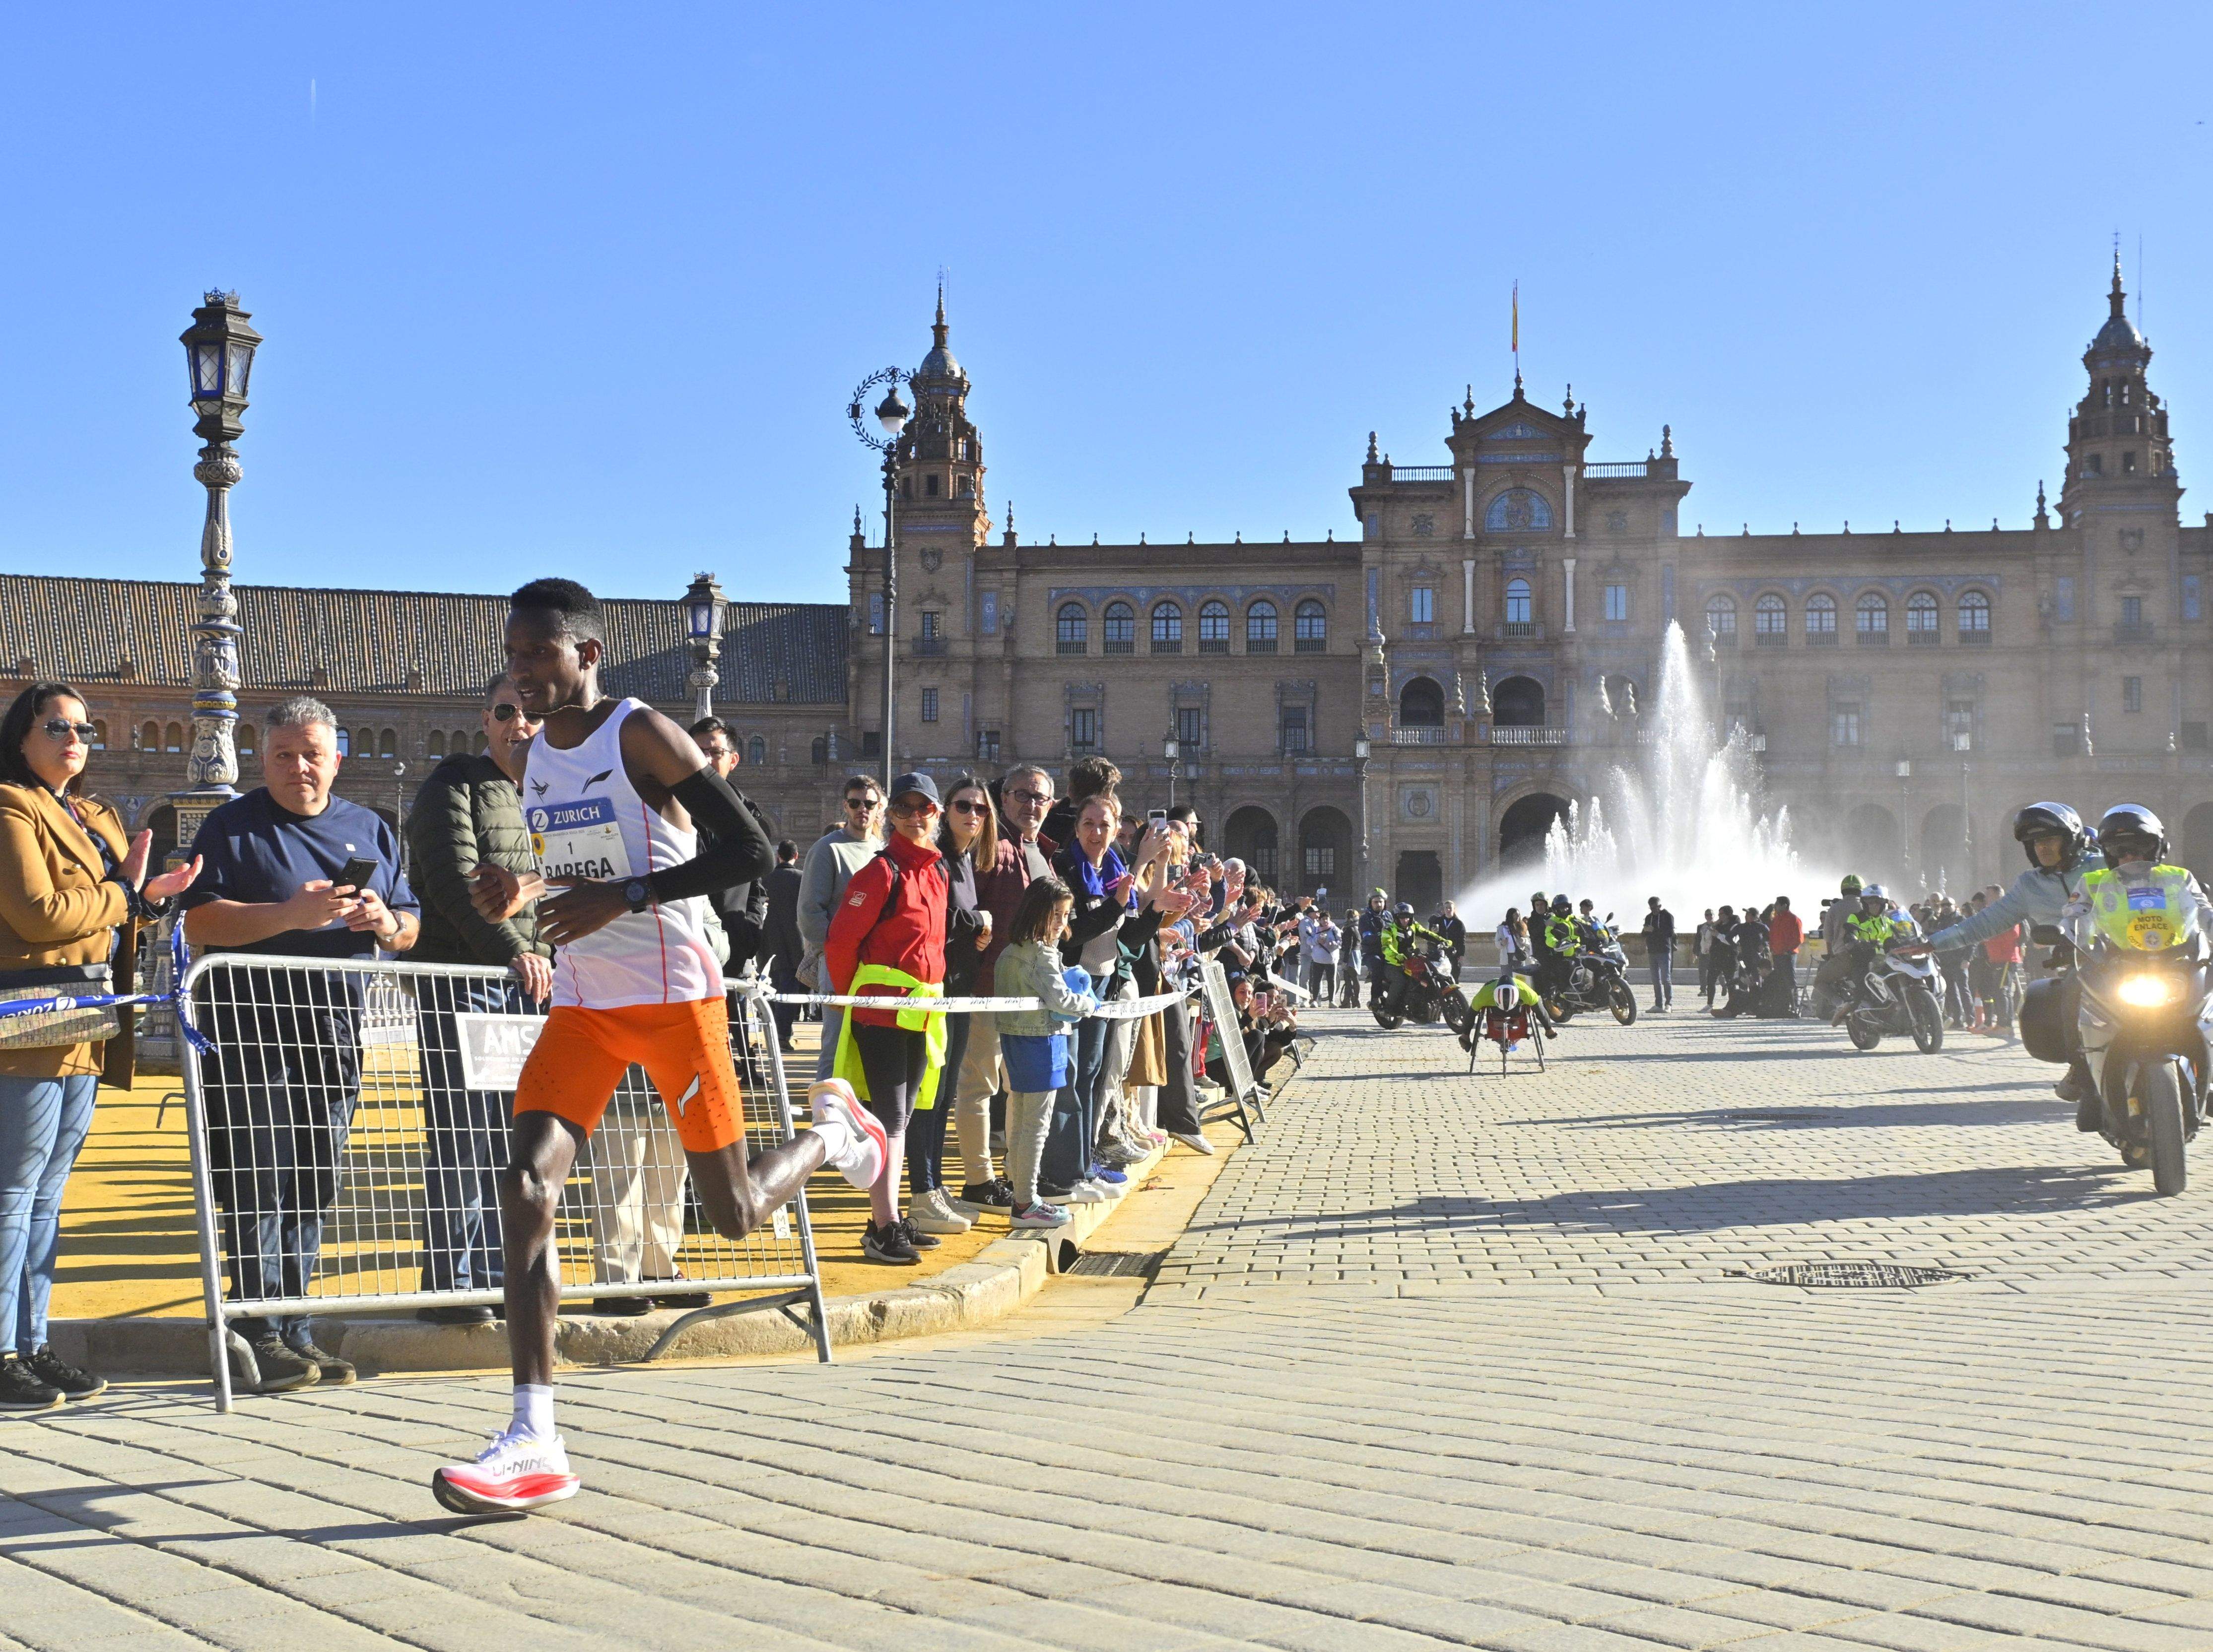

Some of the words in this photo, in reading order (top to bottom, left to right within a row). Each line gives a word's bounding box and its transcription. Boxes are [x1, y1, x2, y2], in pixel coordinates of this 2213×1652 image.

[554, 805, 601, 824] ZURICH
[567, 842, 573, 855] 1
[483, 1024, 536, 1055] AMS
